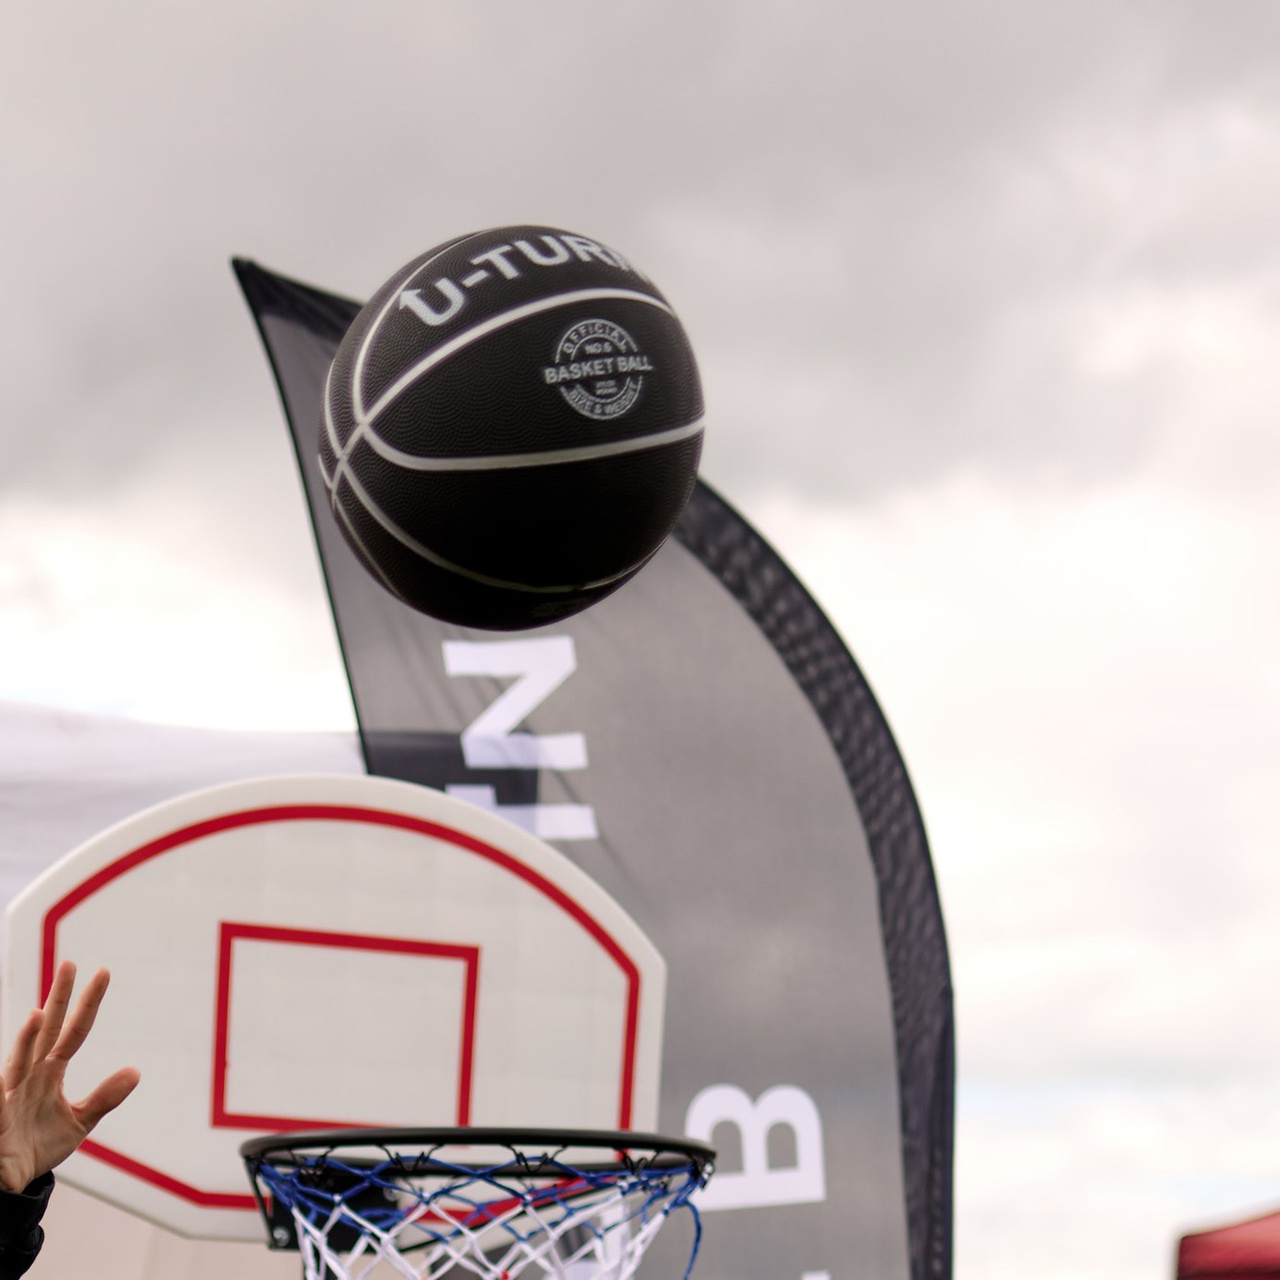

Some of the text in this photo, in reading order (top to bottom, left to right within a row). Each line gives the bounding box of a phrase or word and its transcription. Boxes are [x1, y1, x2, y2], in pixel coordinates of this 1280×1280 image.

[563, 323, 628, 353] OFFICIAL
[544, 355, 653, 384] BASKET BALL
